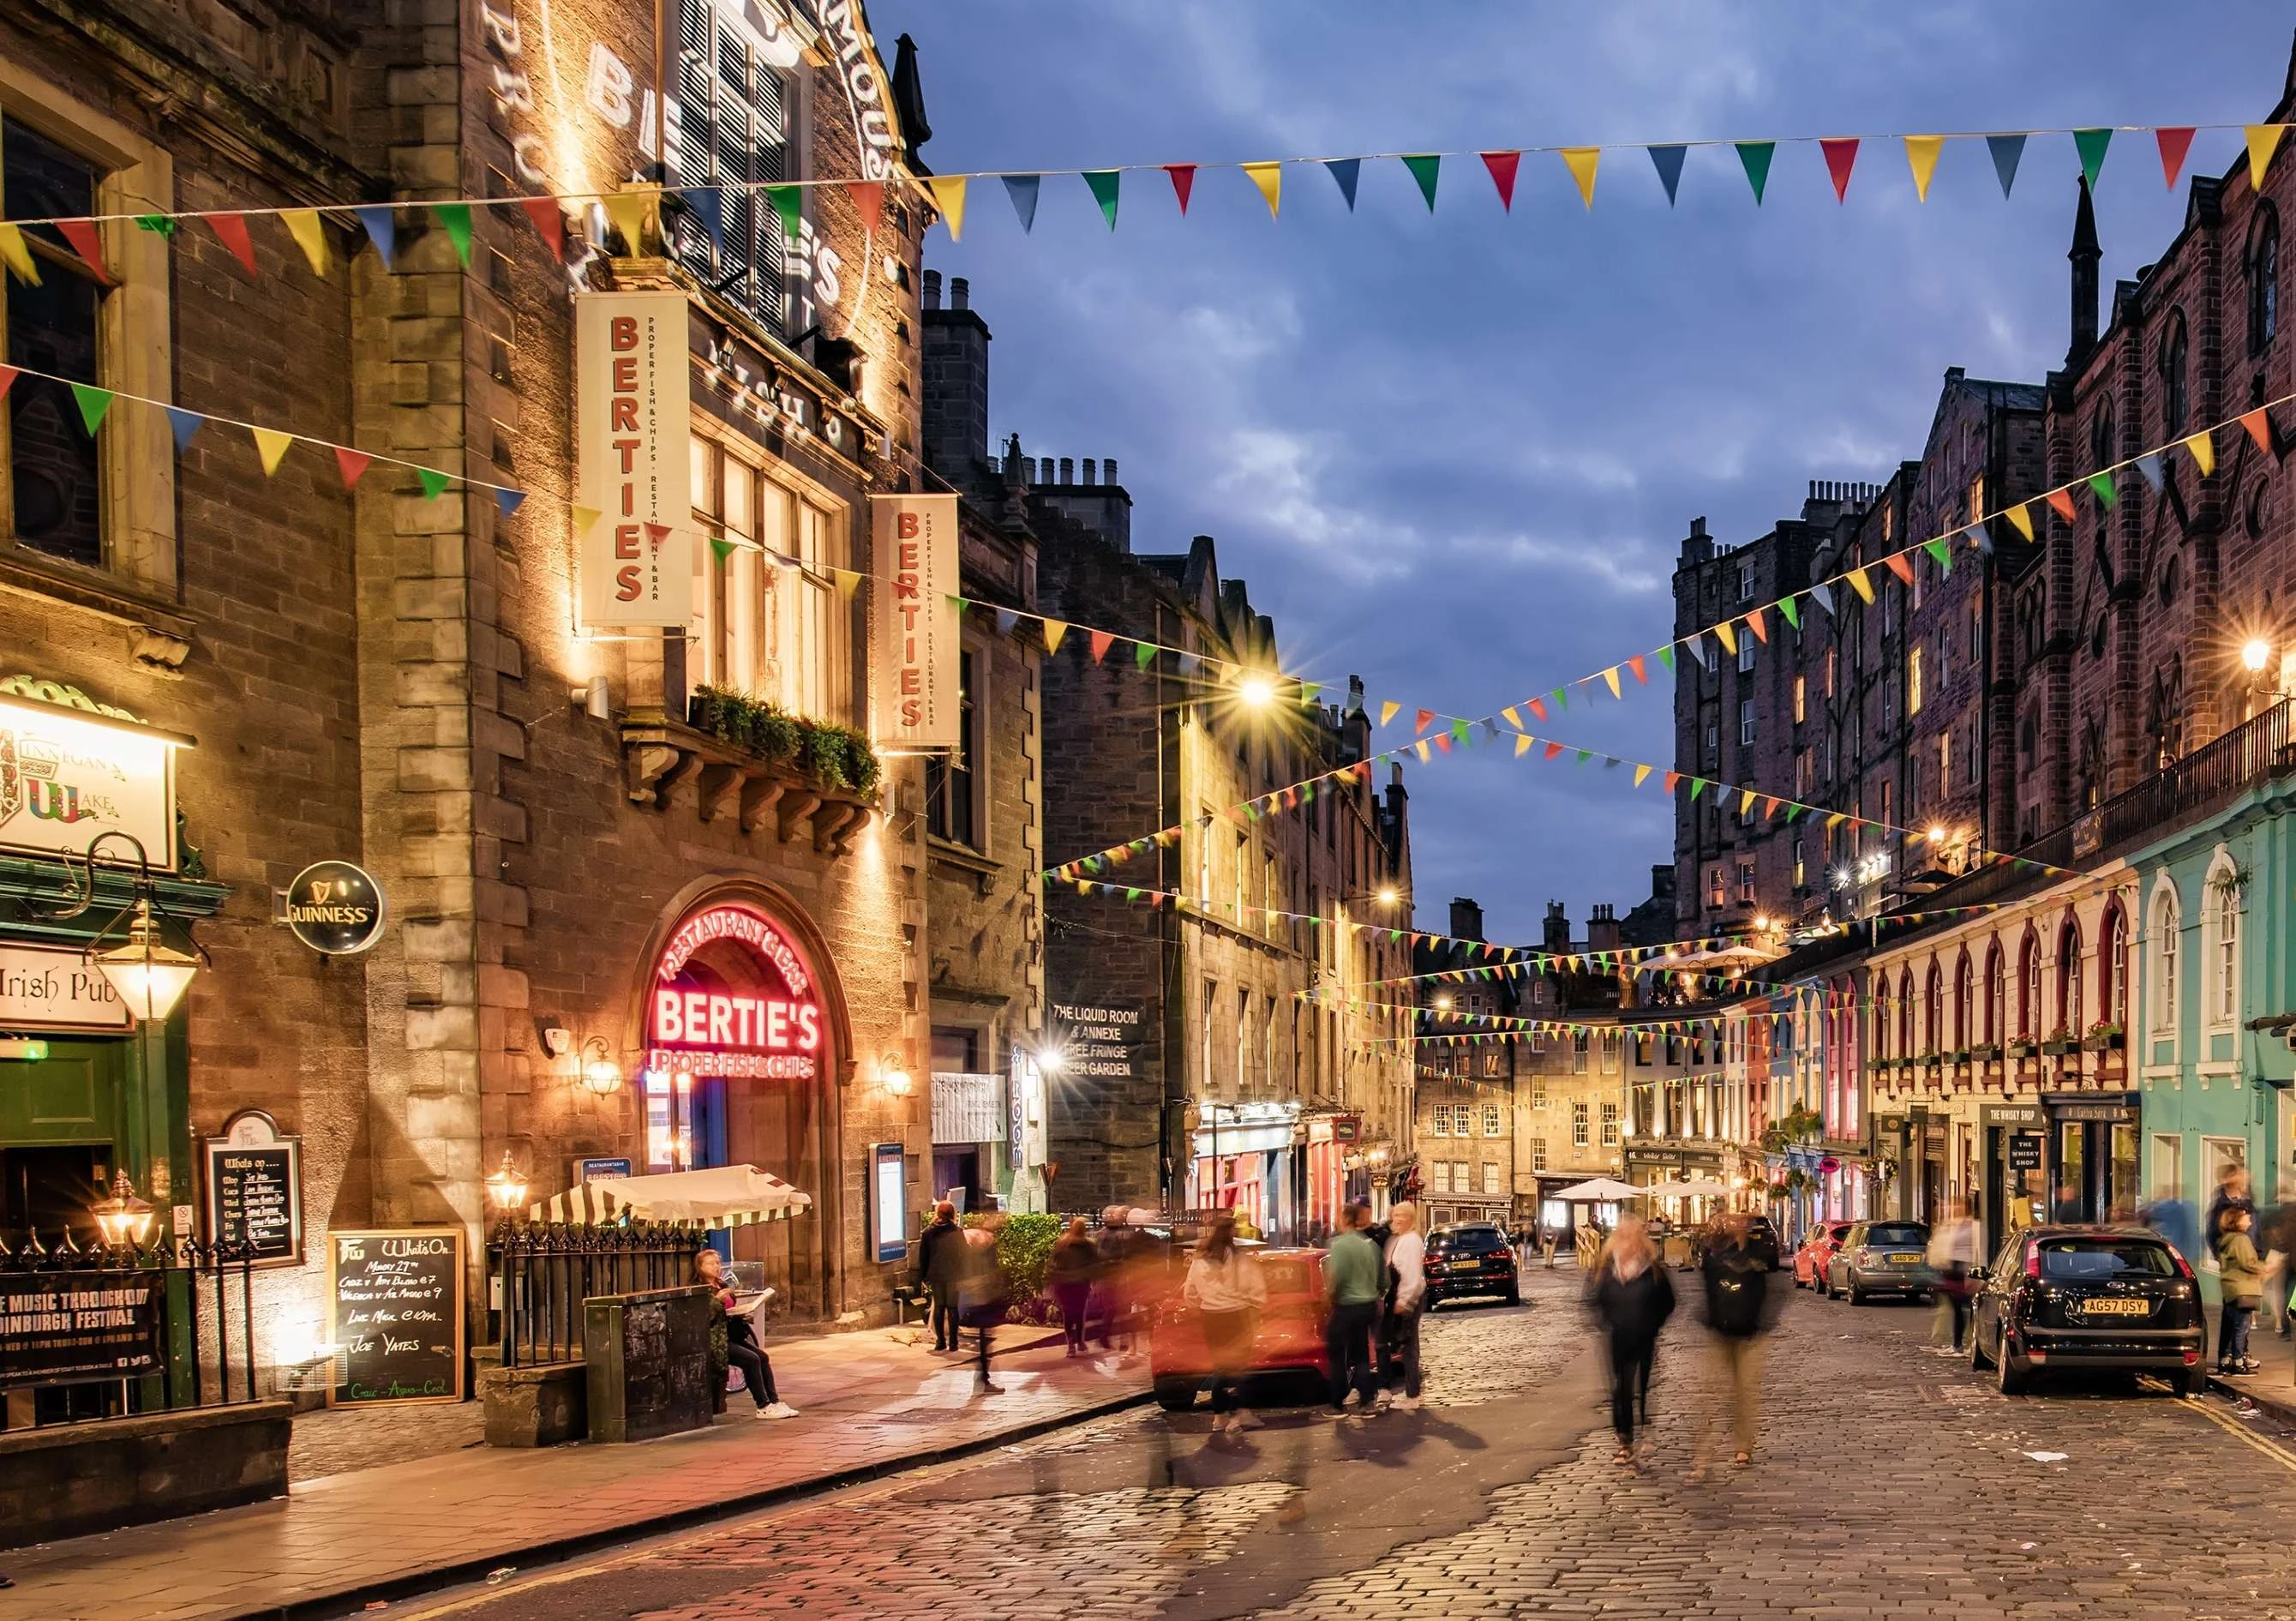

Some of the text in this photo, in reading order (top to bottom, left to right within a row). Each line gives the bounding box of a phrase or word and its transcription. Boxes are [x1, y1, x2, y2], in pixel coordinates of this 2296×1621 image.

[649, 408, 656, 417] &
[610, 315, 643, 602] BERTIES
[651, 564, 658, 573] &
[897, 513, 922, 727] BERTIES
[289, 904, 369, 925] GUINNESS
[658, 911, 809, 999] RESTAURANT & BAR
[656, 988, 819, 1051] BERTIE'S
[1053, 1005, 1138, 1024] THE LIQUID ROOM
[1070, 1024, 1121, 1041] & ANNEXE
[1064, 1043, 1128, 1058] FREE FRINGE
[651, 1048, 722, 1078] PROPER
[725, 1053, 759, 1079] FISH
[768, 1054, 814, 1079] CHIPS
[1088, 1062, 1131, 1076] GARDEN
[1990, 1109, 2035, 1121] THE WHISKY SHOP
[9, 1293, 57, 1313] MUSIC
[60, 1288, 150, 1311] THROUGHOUT
[2089, 1301, 2143, 1312] AG57 DSY
[76, 1309, 135, 1330] FESTIVAL
[350, 1333, 420, 1356] JOE YATES
